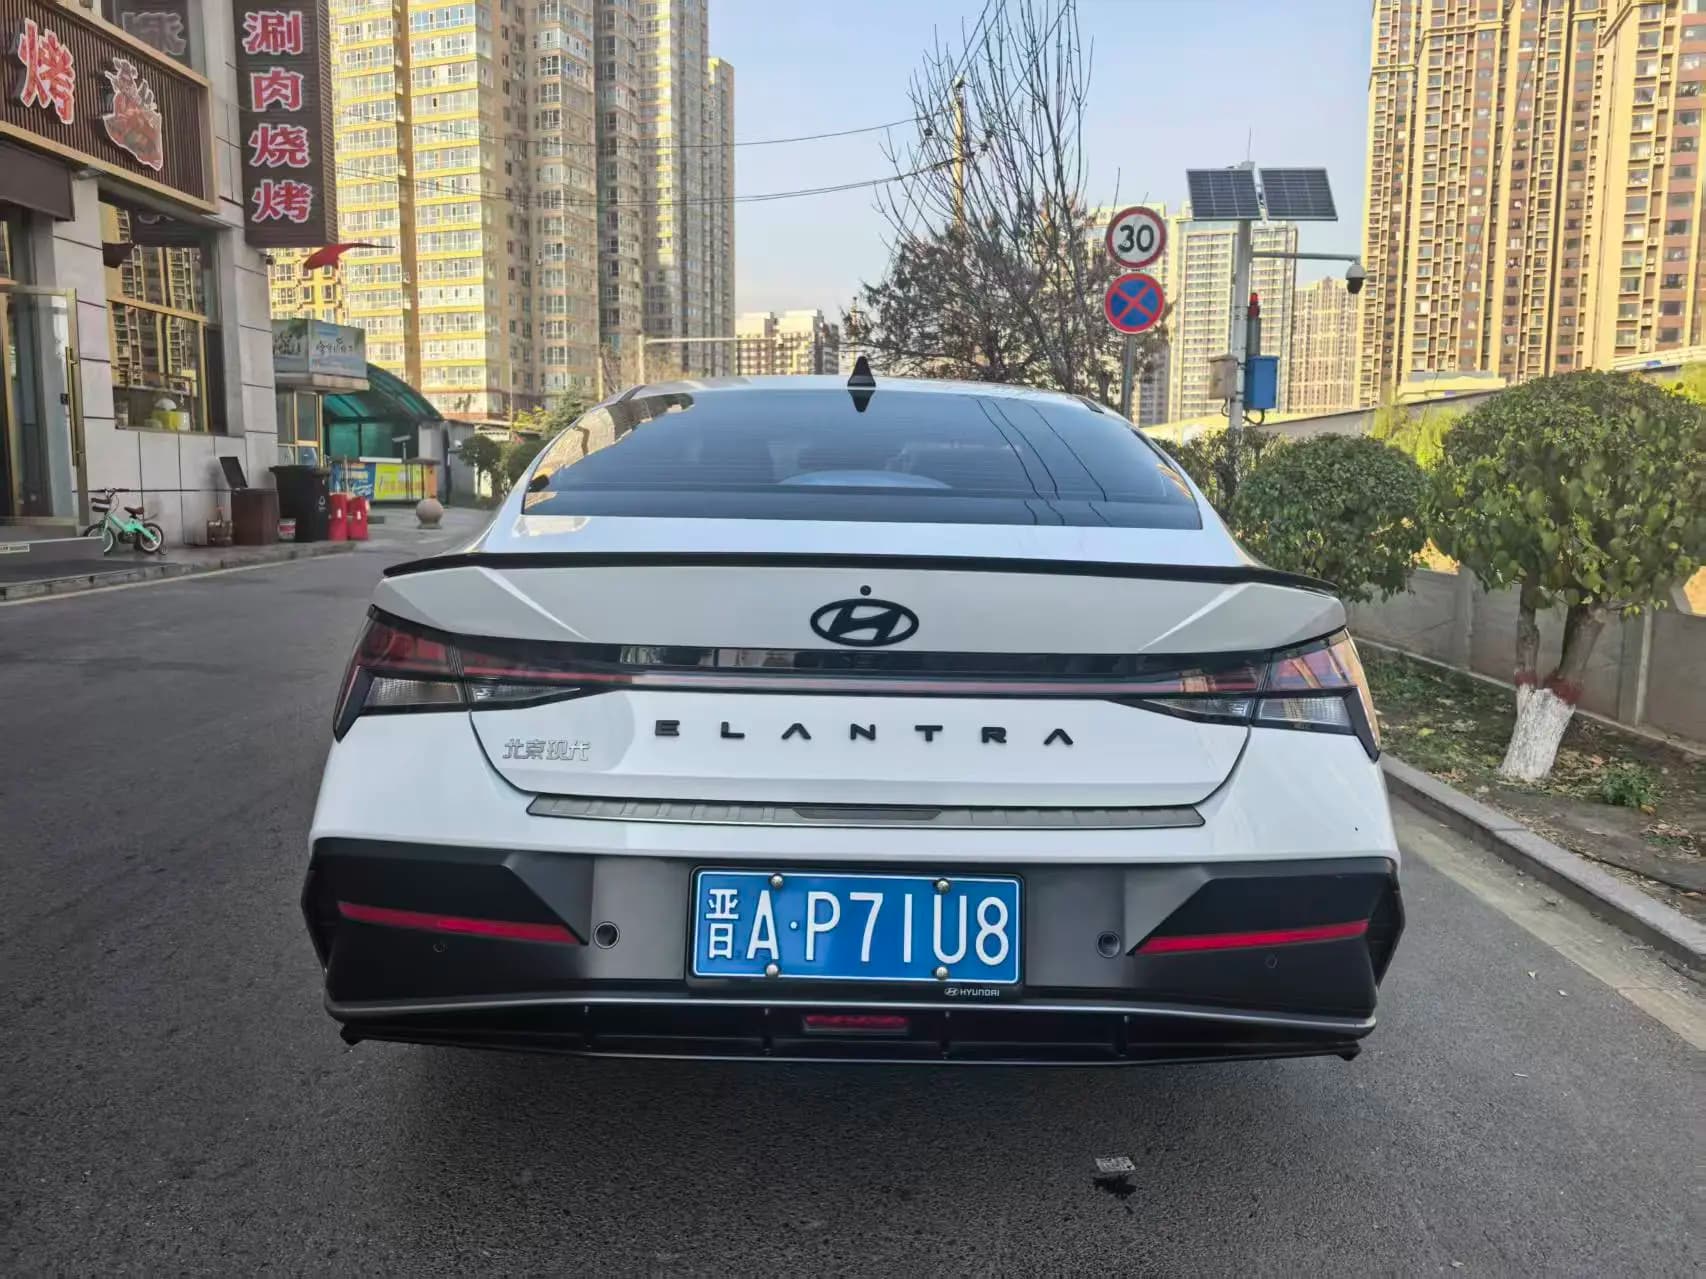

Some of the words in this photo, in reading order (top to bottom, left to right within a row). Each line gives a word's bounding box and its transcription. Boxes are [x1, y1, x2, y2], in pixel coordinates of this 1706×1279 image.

[18, 18, 75, 125] 烤
[243, 10, 314, 224] 涮肉烧烤
[1118, 224, 1154, 253] 30
[654, 719, 1074, 746] ELANTRA
[502, 738, 591, 762] 北京现代
[959, 988, 1000, 997] HYUNDAI
